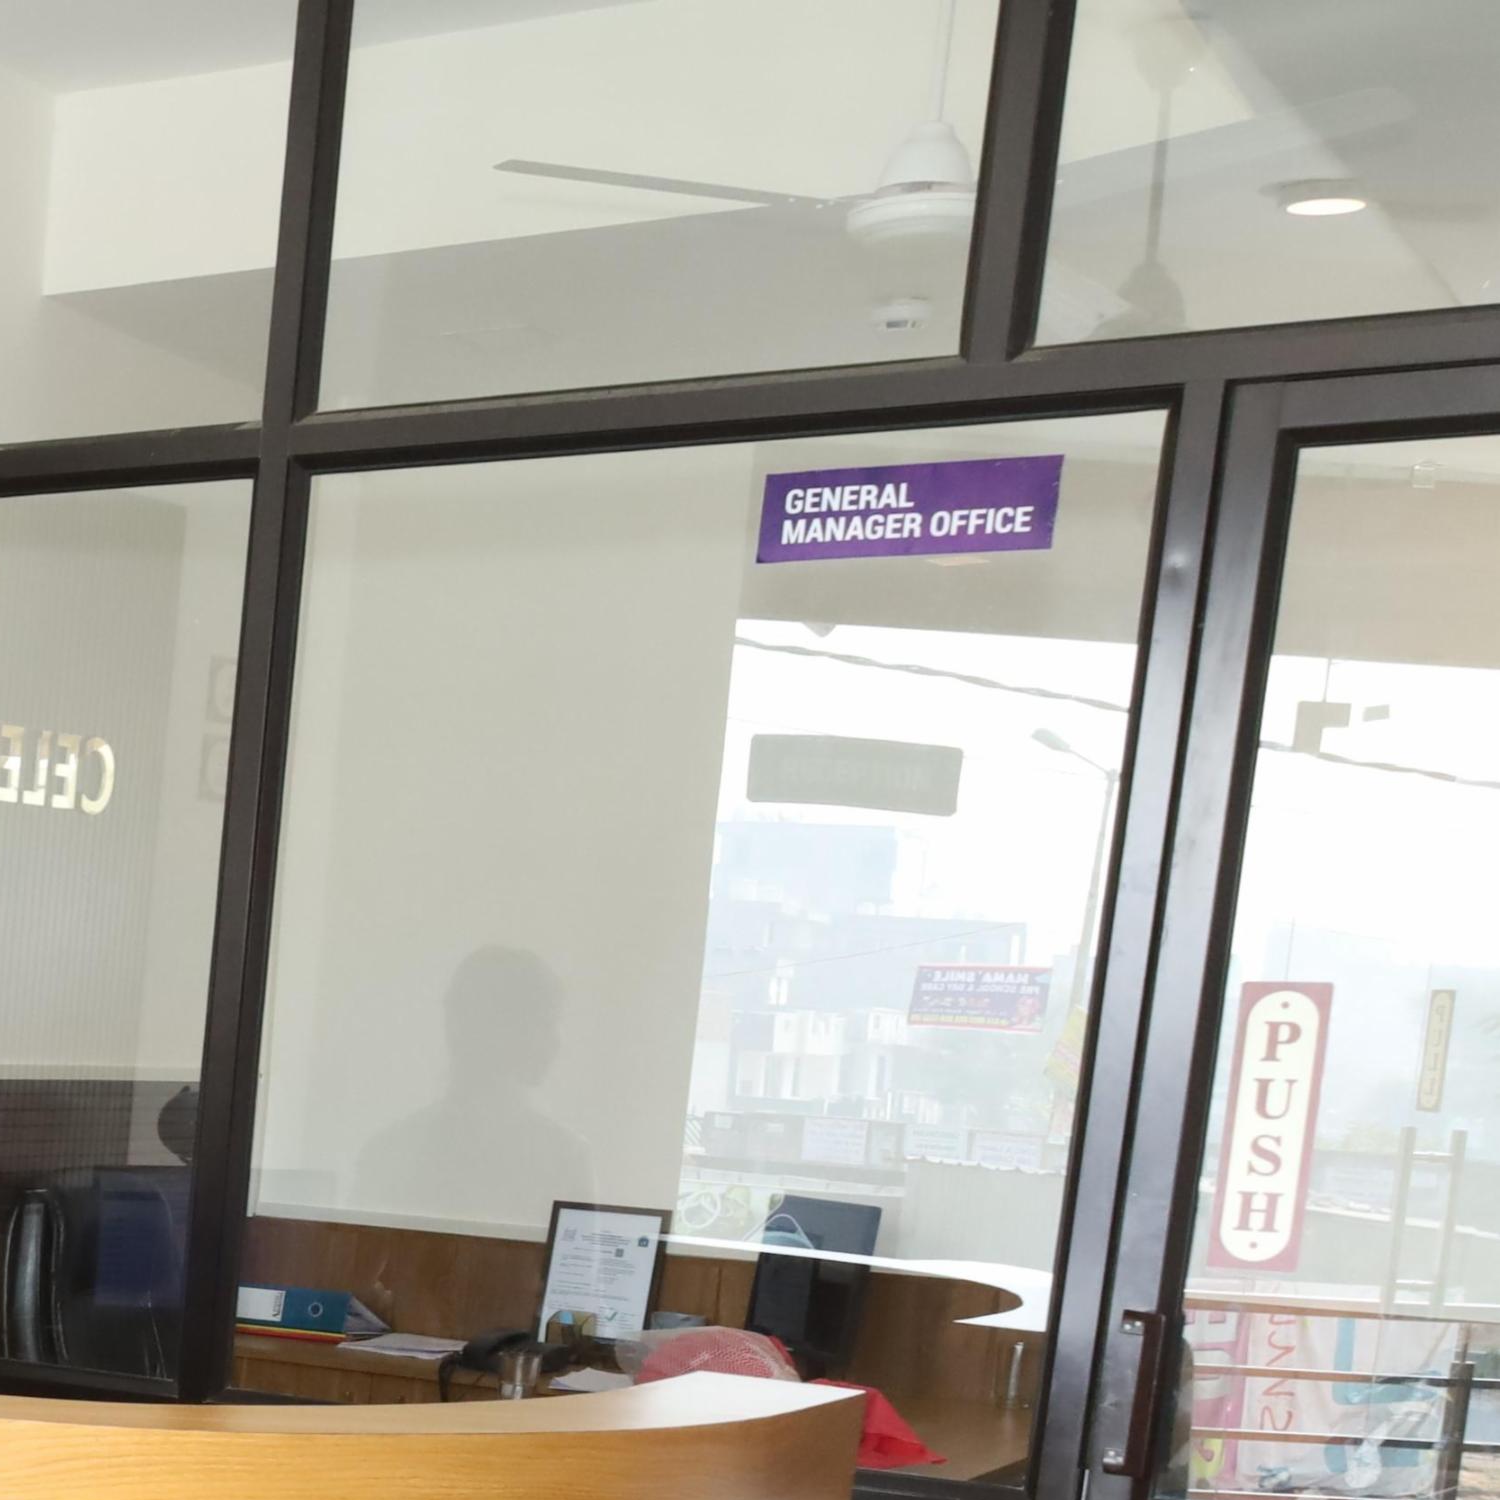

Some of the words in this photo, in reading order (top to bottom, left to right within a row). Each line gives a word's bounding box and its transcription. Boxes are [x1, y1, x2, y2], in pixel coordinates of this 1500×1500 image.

[785, 482, 915, 515] GENERAL
[780, 512, 923, 545] MANAGER
[929, 506, 1035, 538] OFFICE
[1233, 1019, 1303, 1233] PUSH
